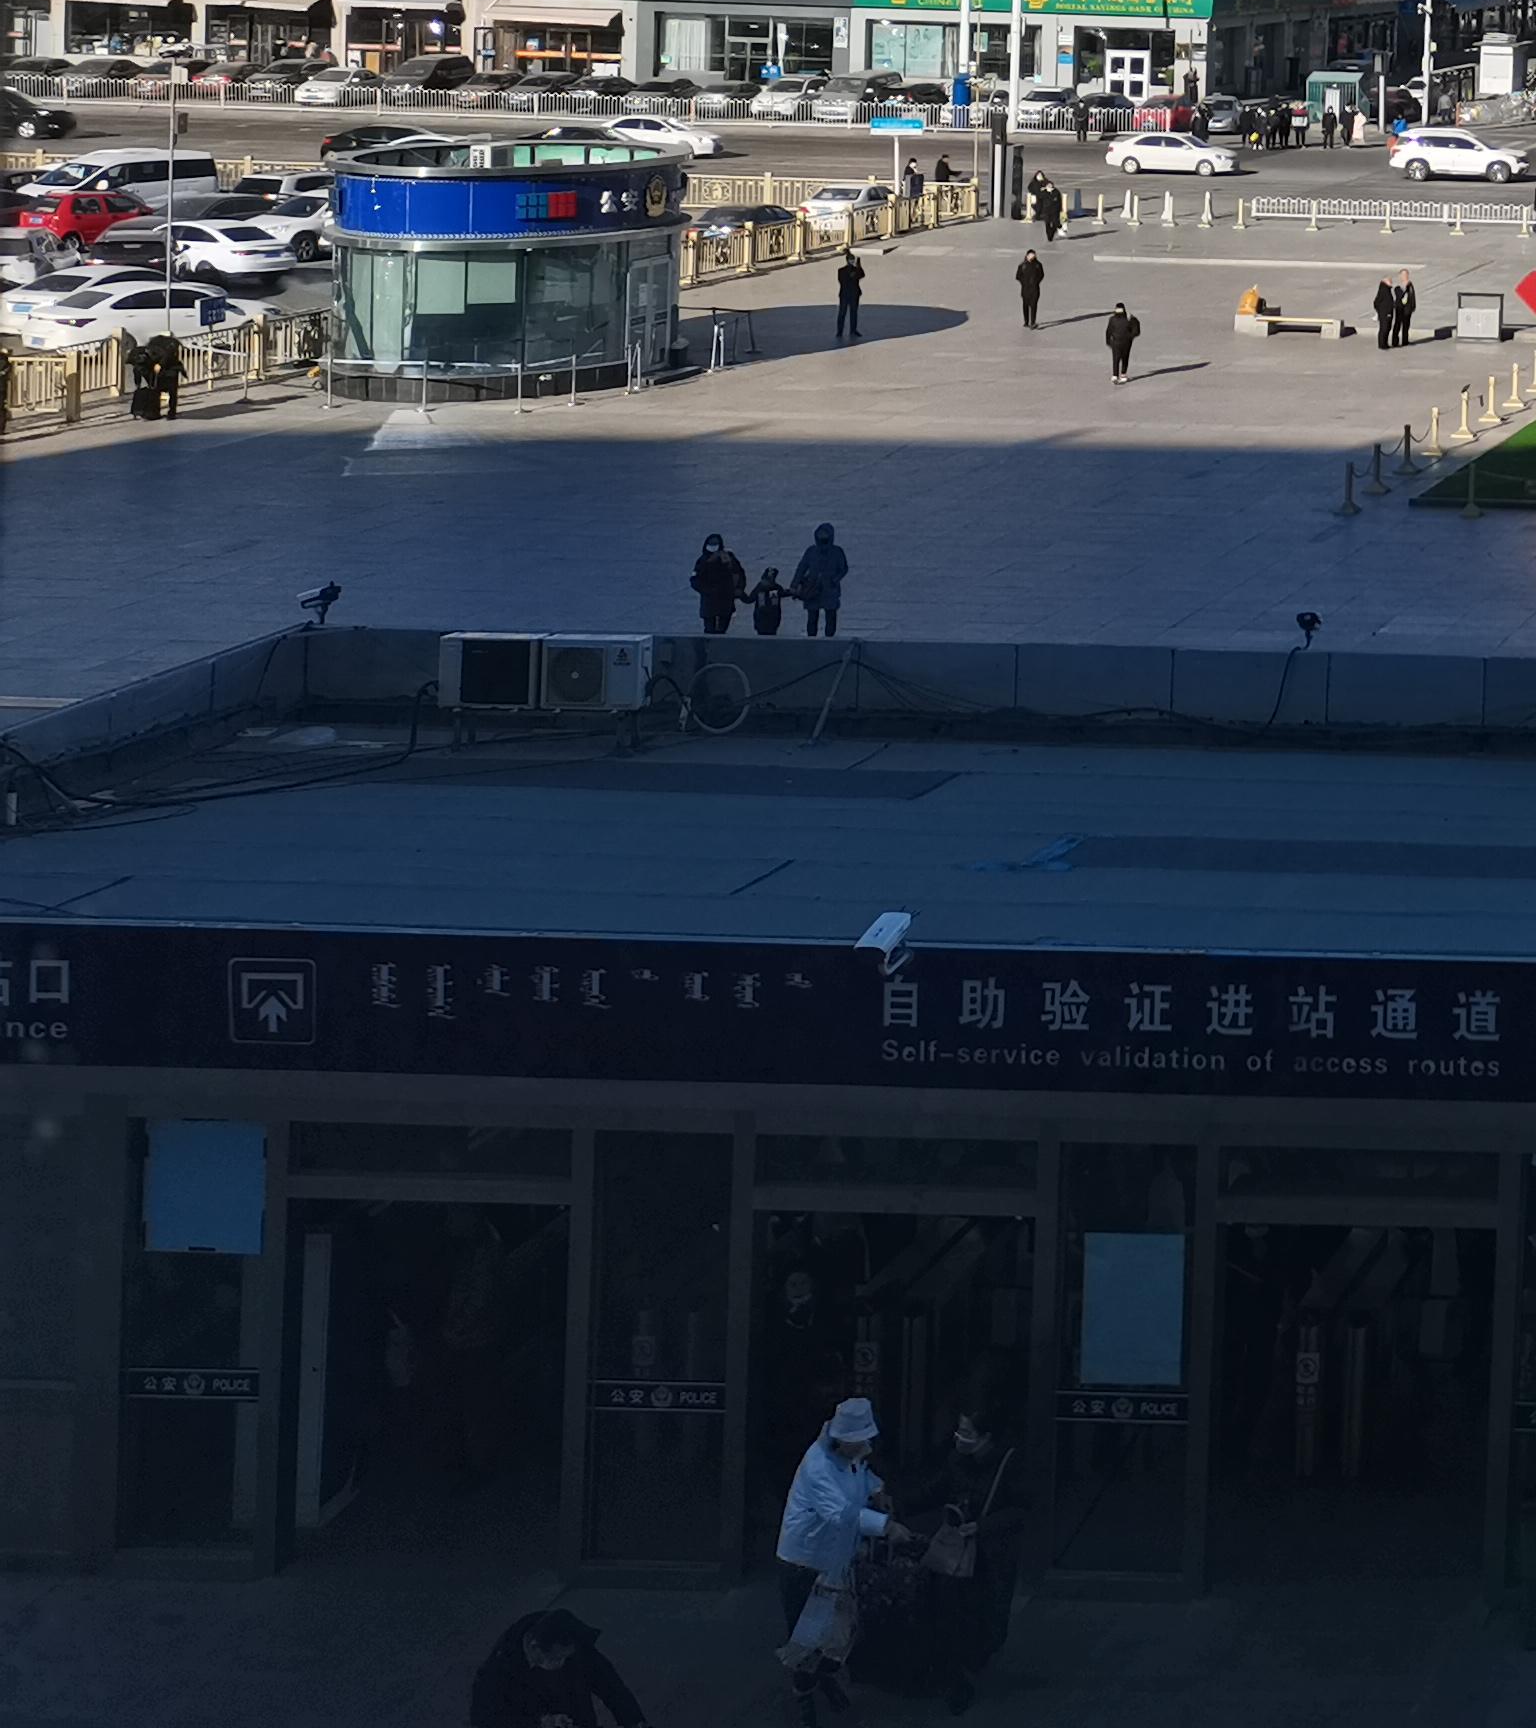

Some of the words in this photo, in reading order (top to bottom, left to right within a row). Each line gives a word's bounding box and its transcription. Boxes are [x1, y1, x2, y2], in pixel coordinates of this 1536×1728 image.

[600, 190, 639, 214] 公安
[882, 975, 1502, 1042] 自助验证进站通道
[880, 1039, 1061, 1066] Self-service
[1081, 1045, 1226, 1072] validation
[1246, 1049, 1274, 1073] of
[1294, 1054, 1388, 1075] access
[1408, 1055, 1501, 1077] routes
[143, 1374, 177, 1392] 公安
[212, 1378, 251, 1393] POLICE
[609, 1388, 645, 1405] 公安
[679, 1391, 718, 1406] POLICE
[1072, 1398, 1106, 1416] 公安
[1139, 1401, 1179, 1418] POLICE
